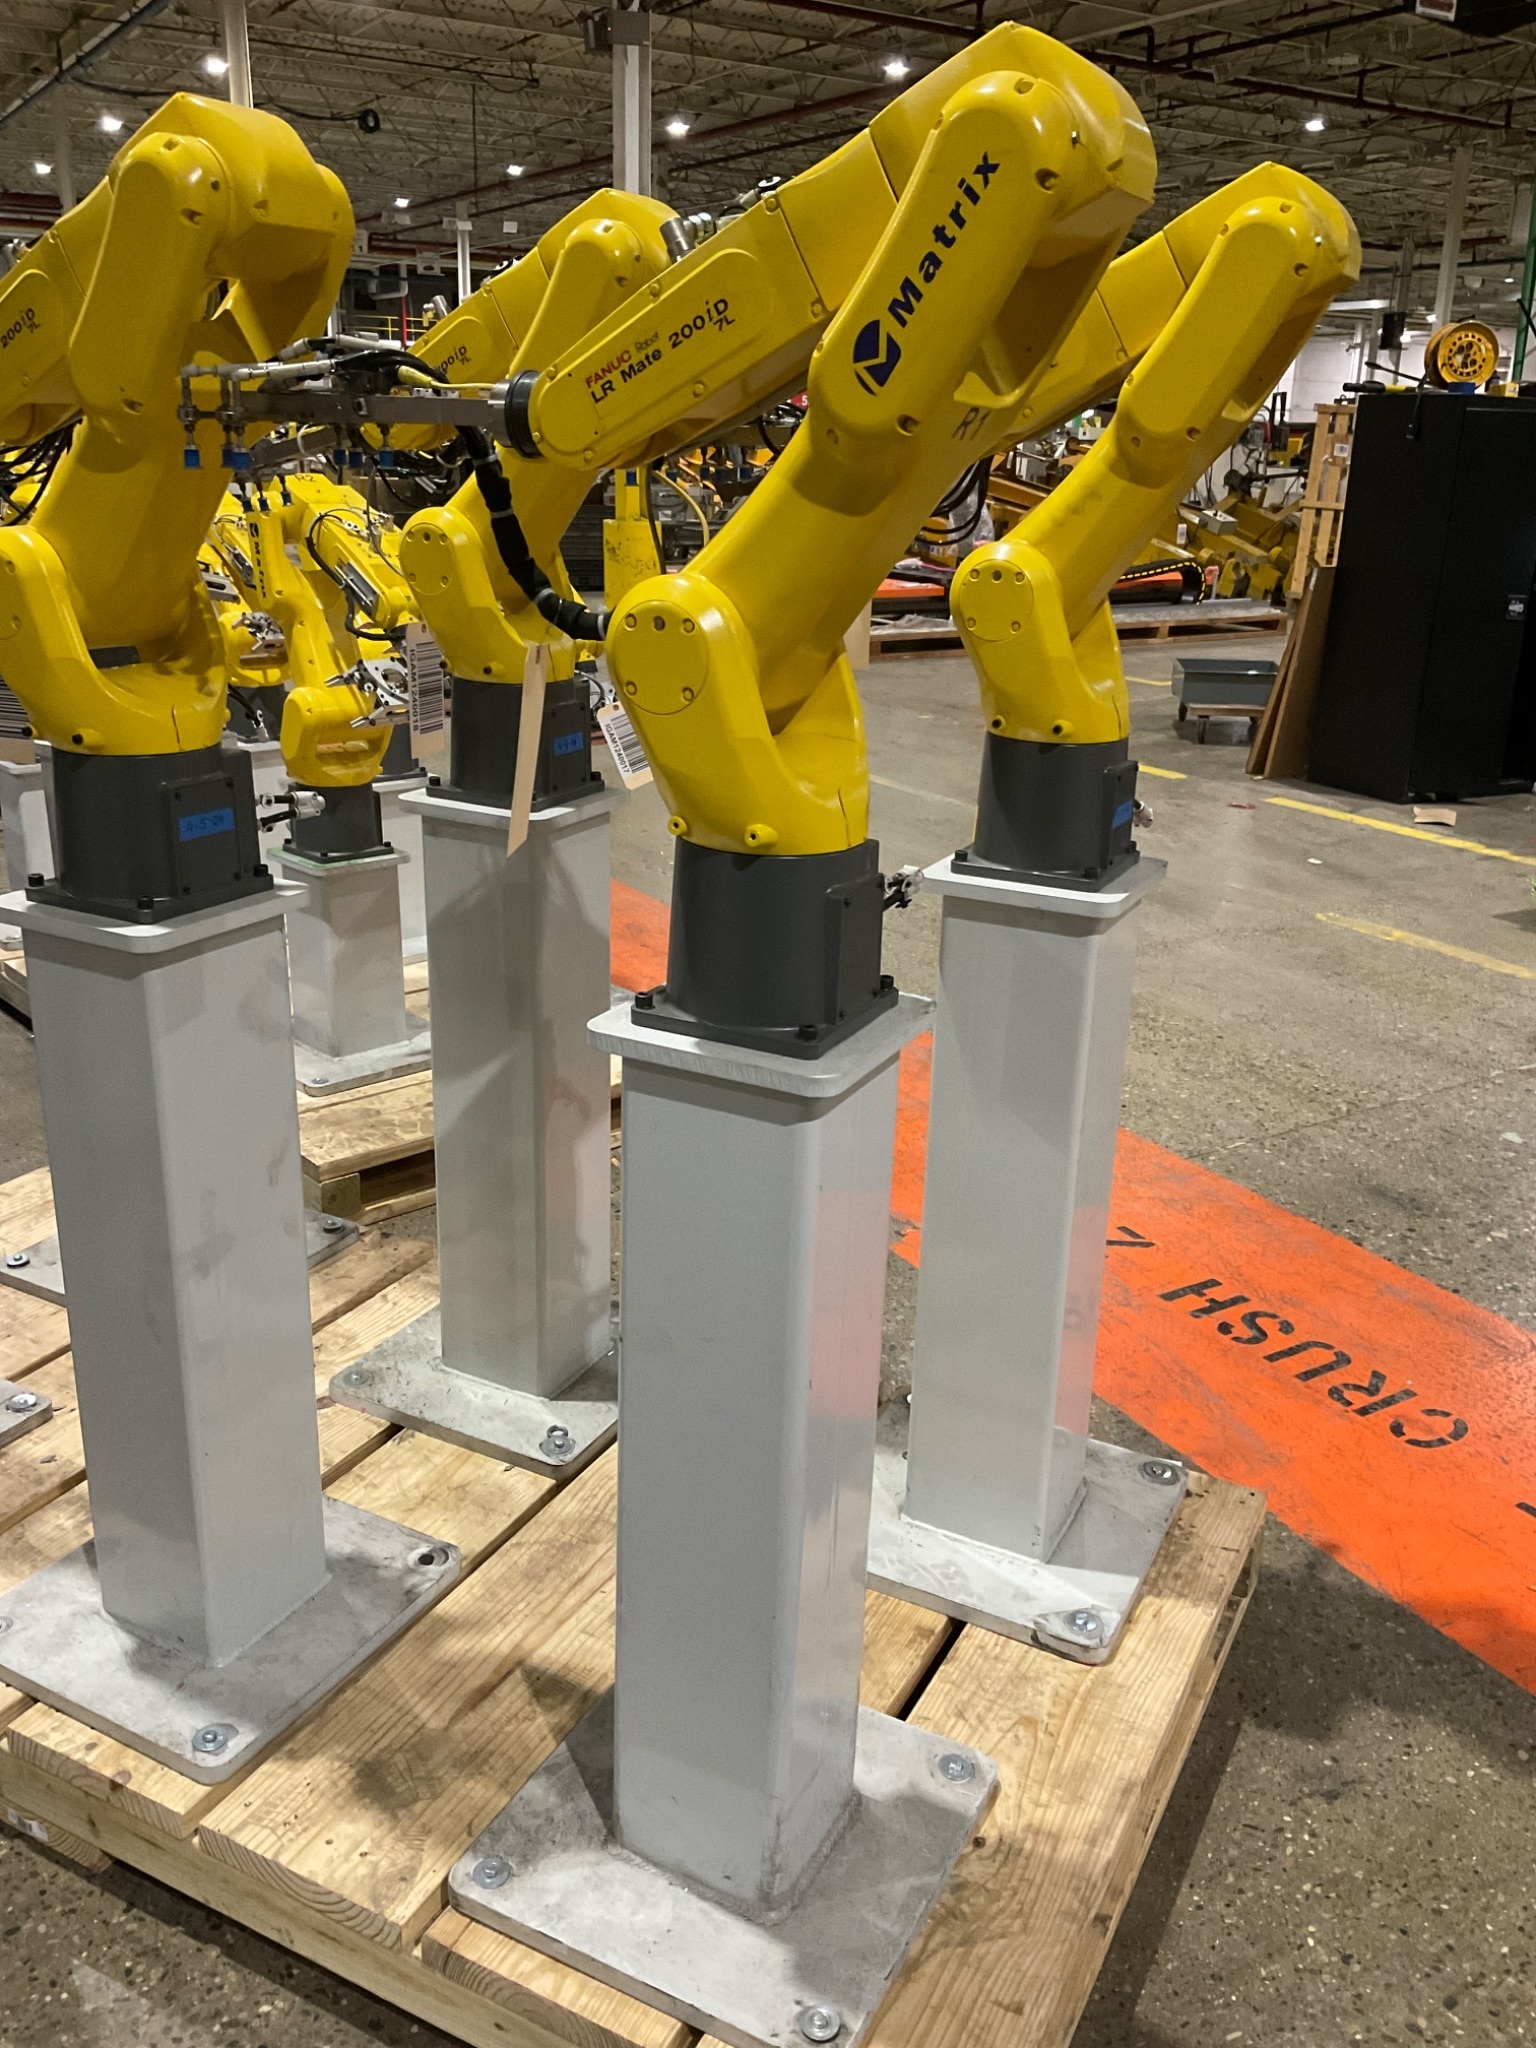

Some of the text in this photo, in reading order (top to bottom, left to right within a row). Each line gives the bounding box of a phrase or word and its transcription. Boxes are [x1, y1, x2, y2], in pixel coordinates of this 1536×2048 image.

[888, 151, 1000, 328] Matrix
[713, 315, 735, 331] 7L
[437, 346, 466, 370] 00iD
[585, 350, 632, 388] FANUC
[590, 298, 729, 404] LR Mate 200iD
[952, 406, 991, 441] R1
[604, 723, 630, 774] IGAM1240017
[1159, 1278, 1469, 1448] CRUSH
